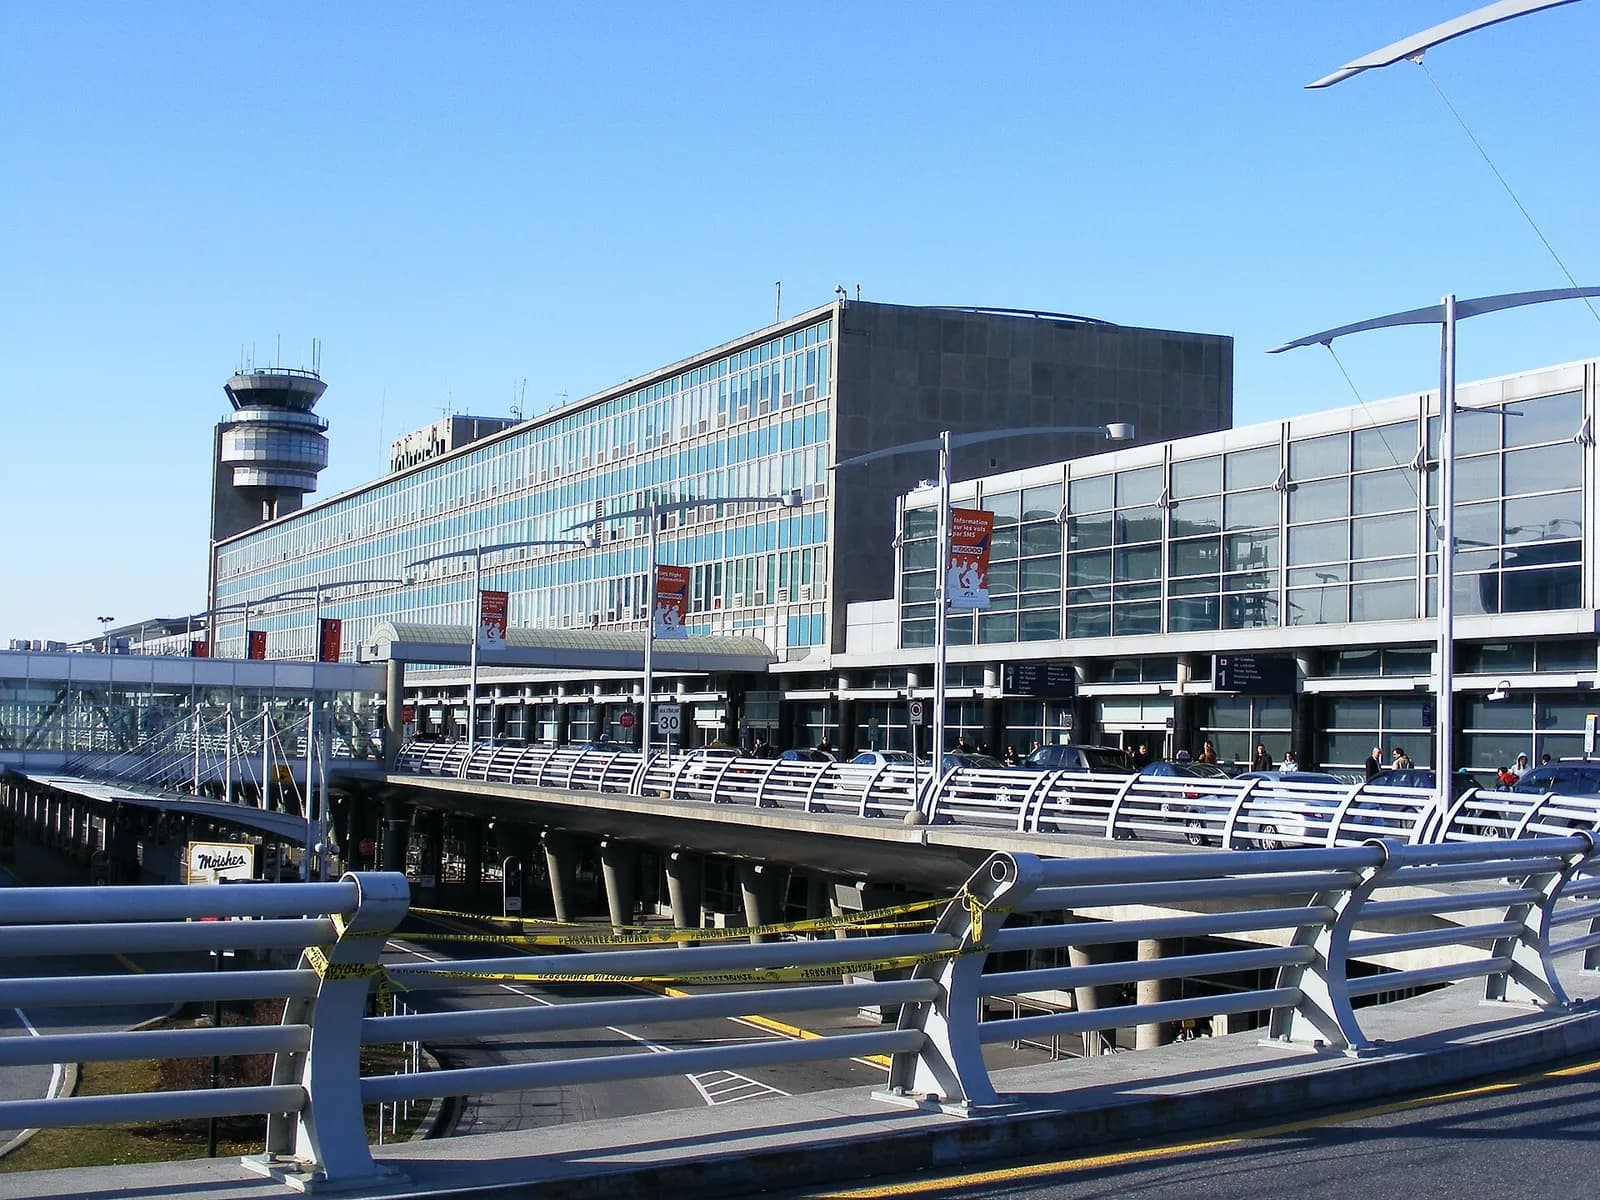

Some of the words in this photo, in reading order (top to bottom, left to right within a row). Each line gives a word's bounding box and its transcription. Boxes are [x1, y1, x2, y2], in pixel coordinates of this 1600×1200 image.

[953, 517, 988, 526] Information
[1006, 675, 1013, 689] 1
[1218, 670, 1226, 687] 1
[660, 716, 679, 729] 30
[198, 850, 247, 870] Moishes
